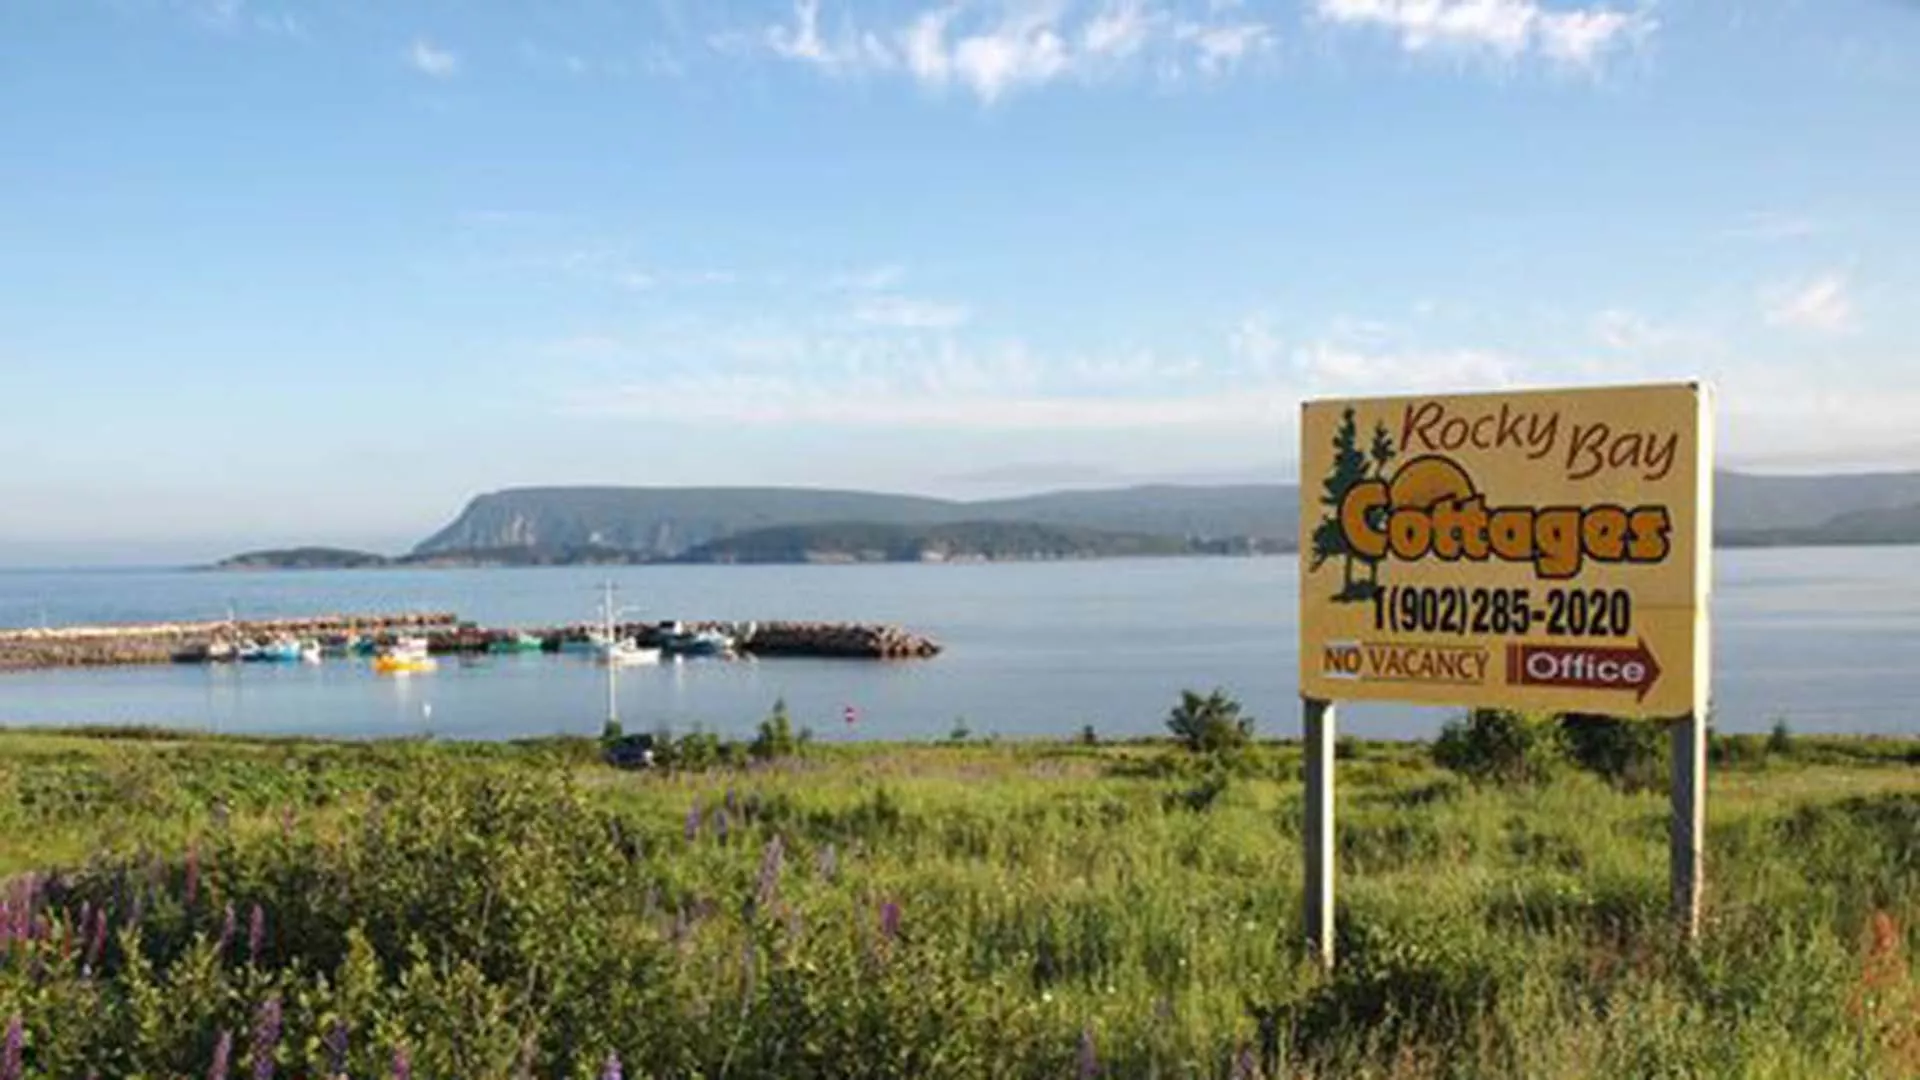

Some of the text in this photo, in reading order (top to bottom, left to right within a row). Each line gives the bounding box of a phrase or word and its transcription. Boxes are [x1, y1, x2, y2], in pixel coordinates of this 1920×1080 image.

[1400, 402, 1678, 480] Rocky Bay
[1339, 479, 1672, 579] Cottages
[1372, 585, 1631, 637] 1(902)285-2020
[1323, 647, 1490, 680] NO VACANCY
[1526, 652, 1646, 683] Office
